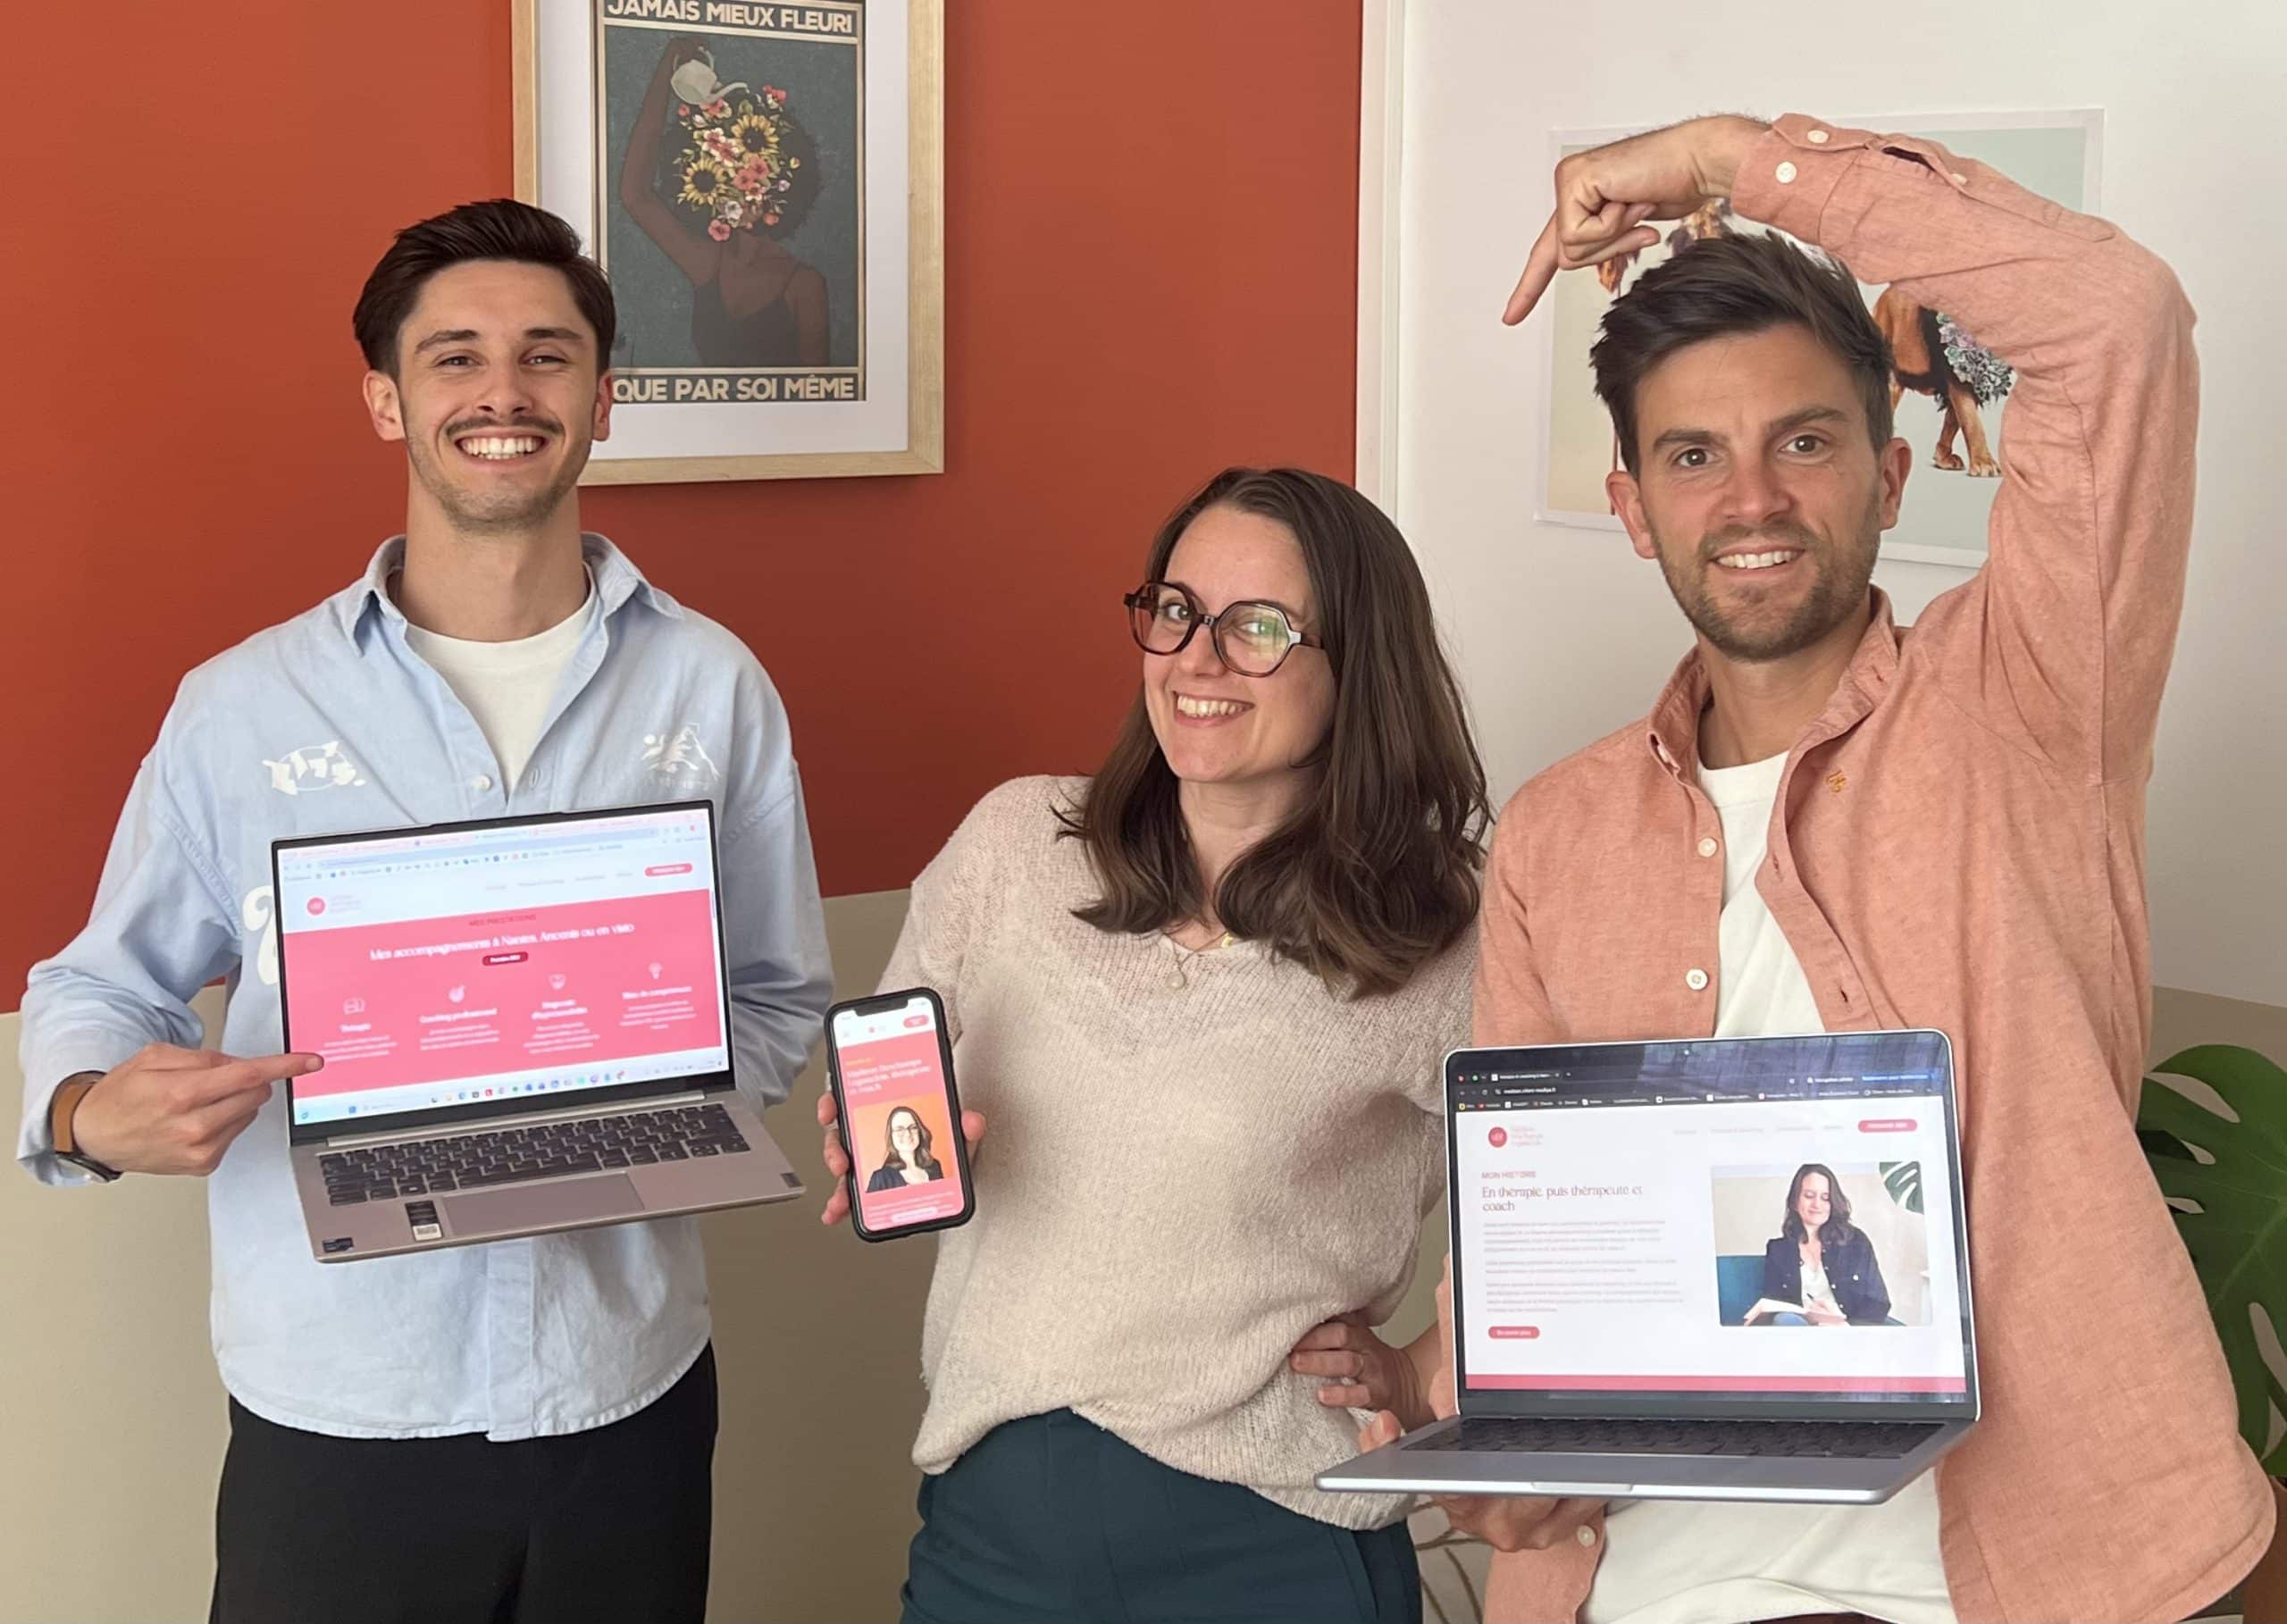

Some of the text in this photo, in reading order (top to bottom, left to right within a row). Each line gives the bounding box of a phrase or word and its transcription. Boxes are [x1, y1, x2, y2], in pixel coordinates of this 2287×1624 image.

[607, 0, 853, 34] JAMAIS MIEUX FLEURI
[613, 373, 854, 402] QUE PAR SOI MÊME
[393, 939, 491, 958] accompagnements
[1482, 1186, 1495, 1198] En
[1546, 1186, 1570, 1200] puis
[1631, 1185, 1643, 1196] et
[1482, 1201, 1515, 1212] coach
